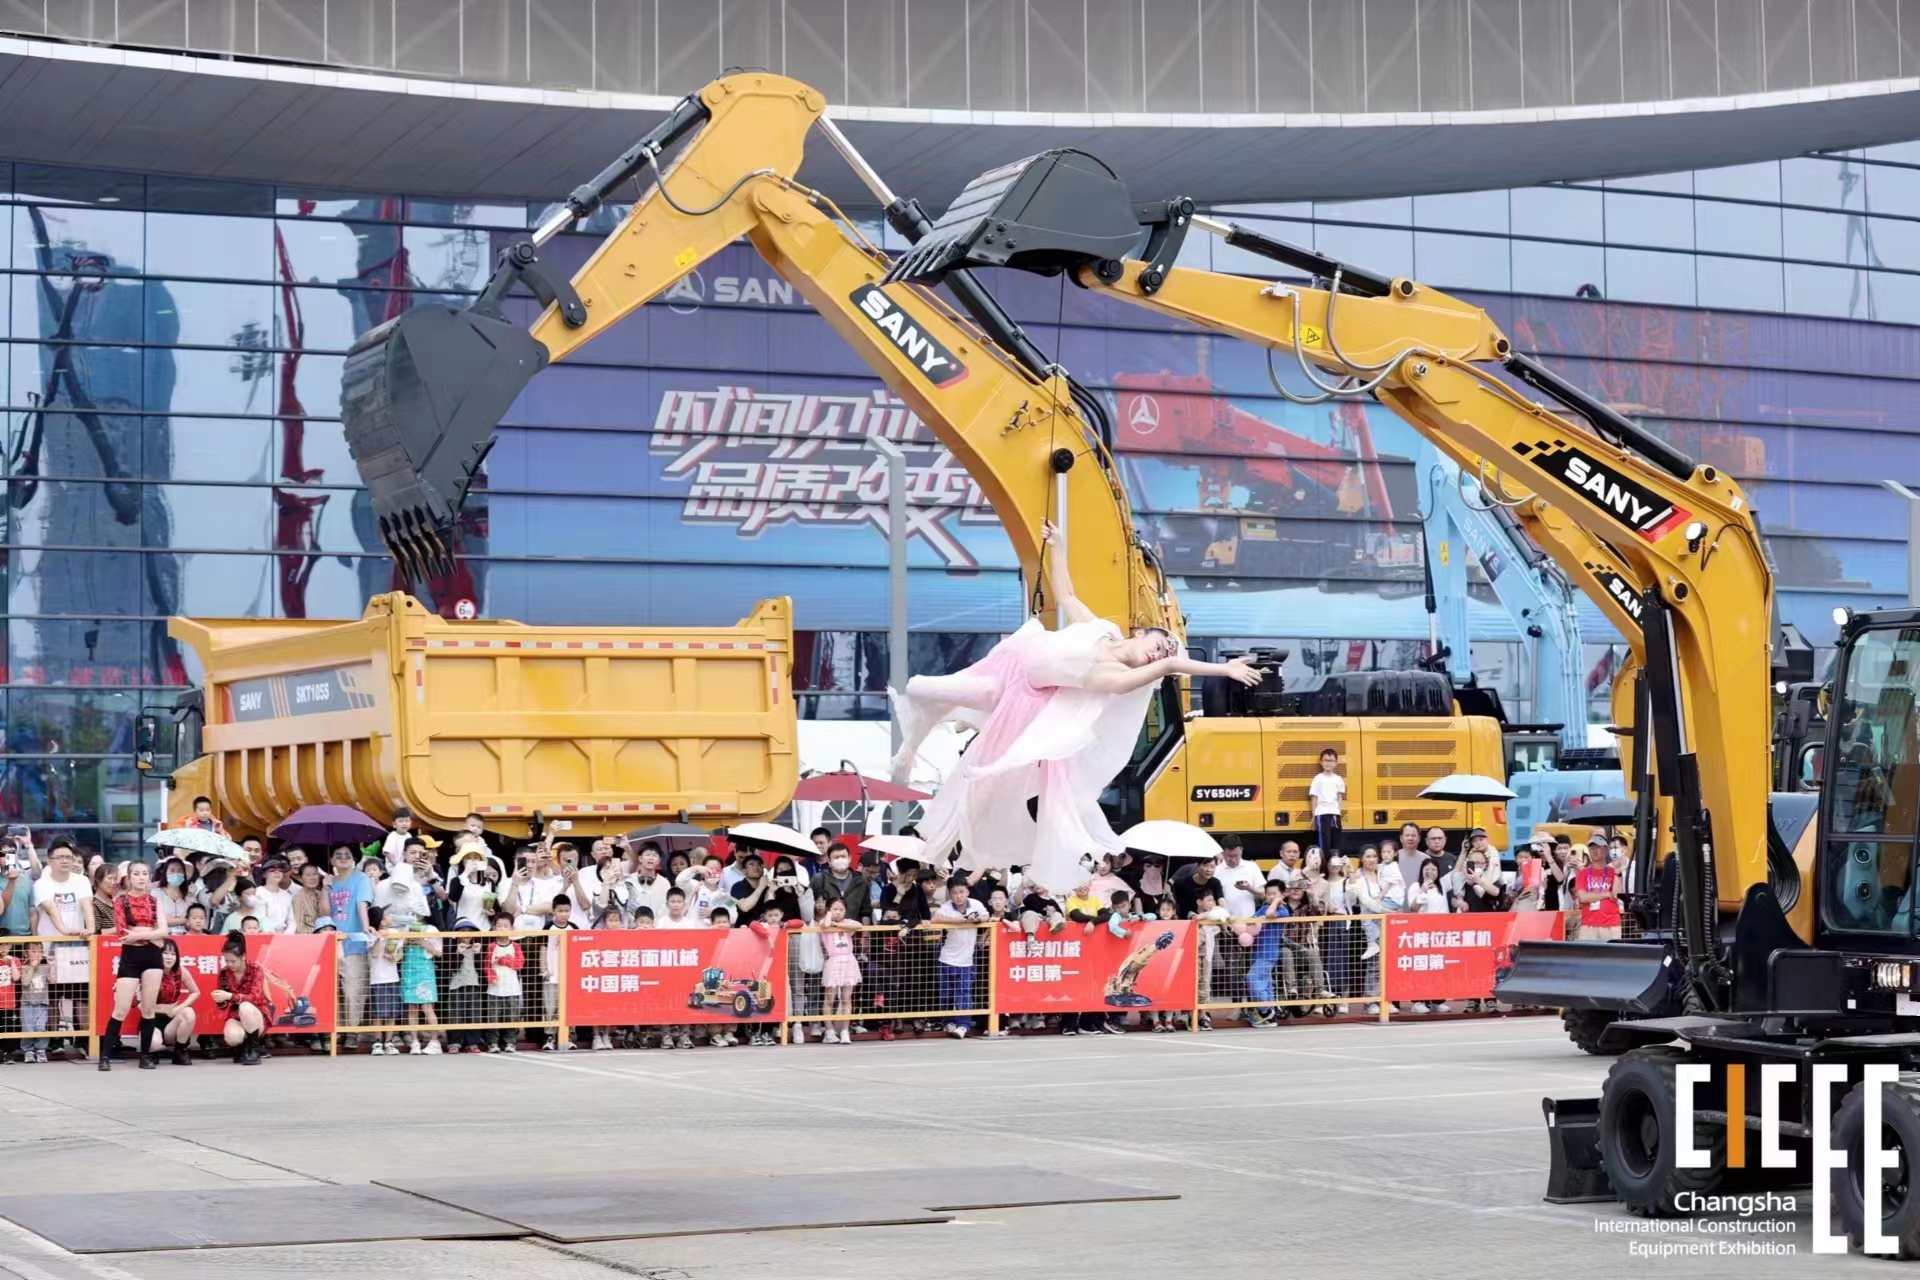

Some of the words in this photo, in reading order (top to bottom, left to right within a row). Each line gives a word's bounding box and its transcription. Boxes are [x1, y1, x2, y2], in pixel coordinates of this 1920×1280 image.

[714, 277, 812, 305] SAN
[860, 290, 949, 373] SANY
[1564, 456, 1653, 524] SANY
[1608, 577, 1643, 619] SAN
[239, 691, 262, 712] SANY
[296, 682, 330, 704] SKT105S
[1196, 788, 1251, 799] SY650H-S
[1397, 930, 1492, 948] 大吨位起重机
[581, 948, 699, 968] 成套路面机械
[1397, 954, 1460, 971] 中国第一
[581, 974, 660, 993] 中国第一
[1009, 965, 1080, 982] 中国第一
